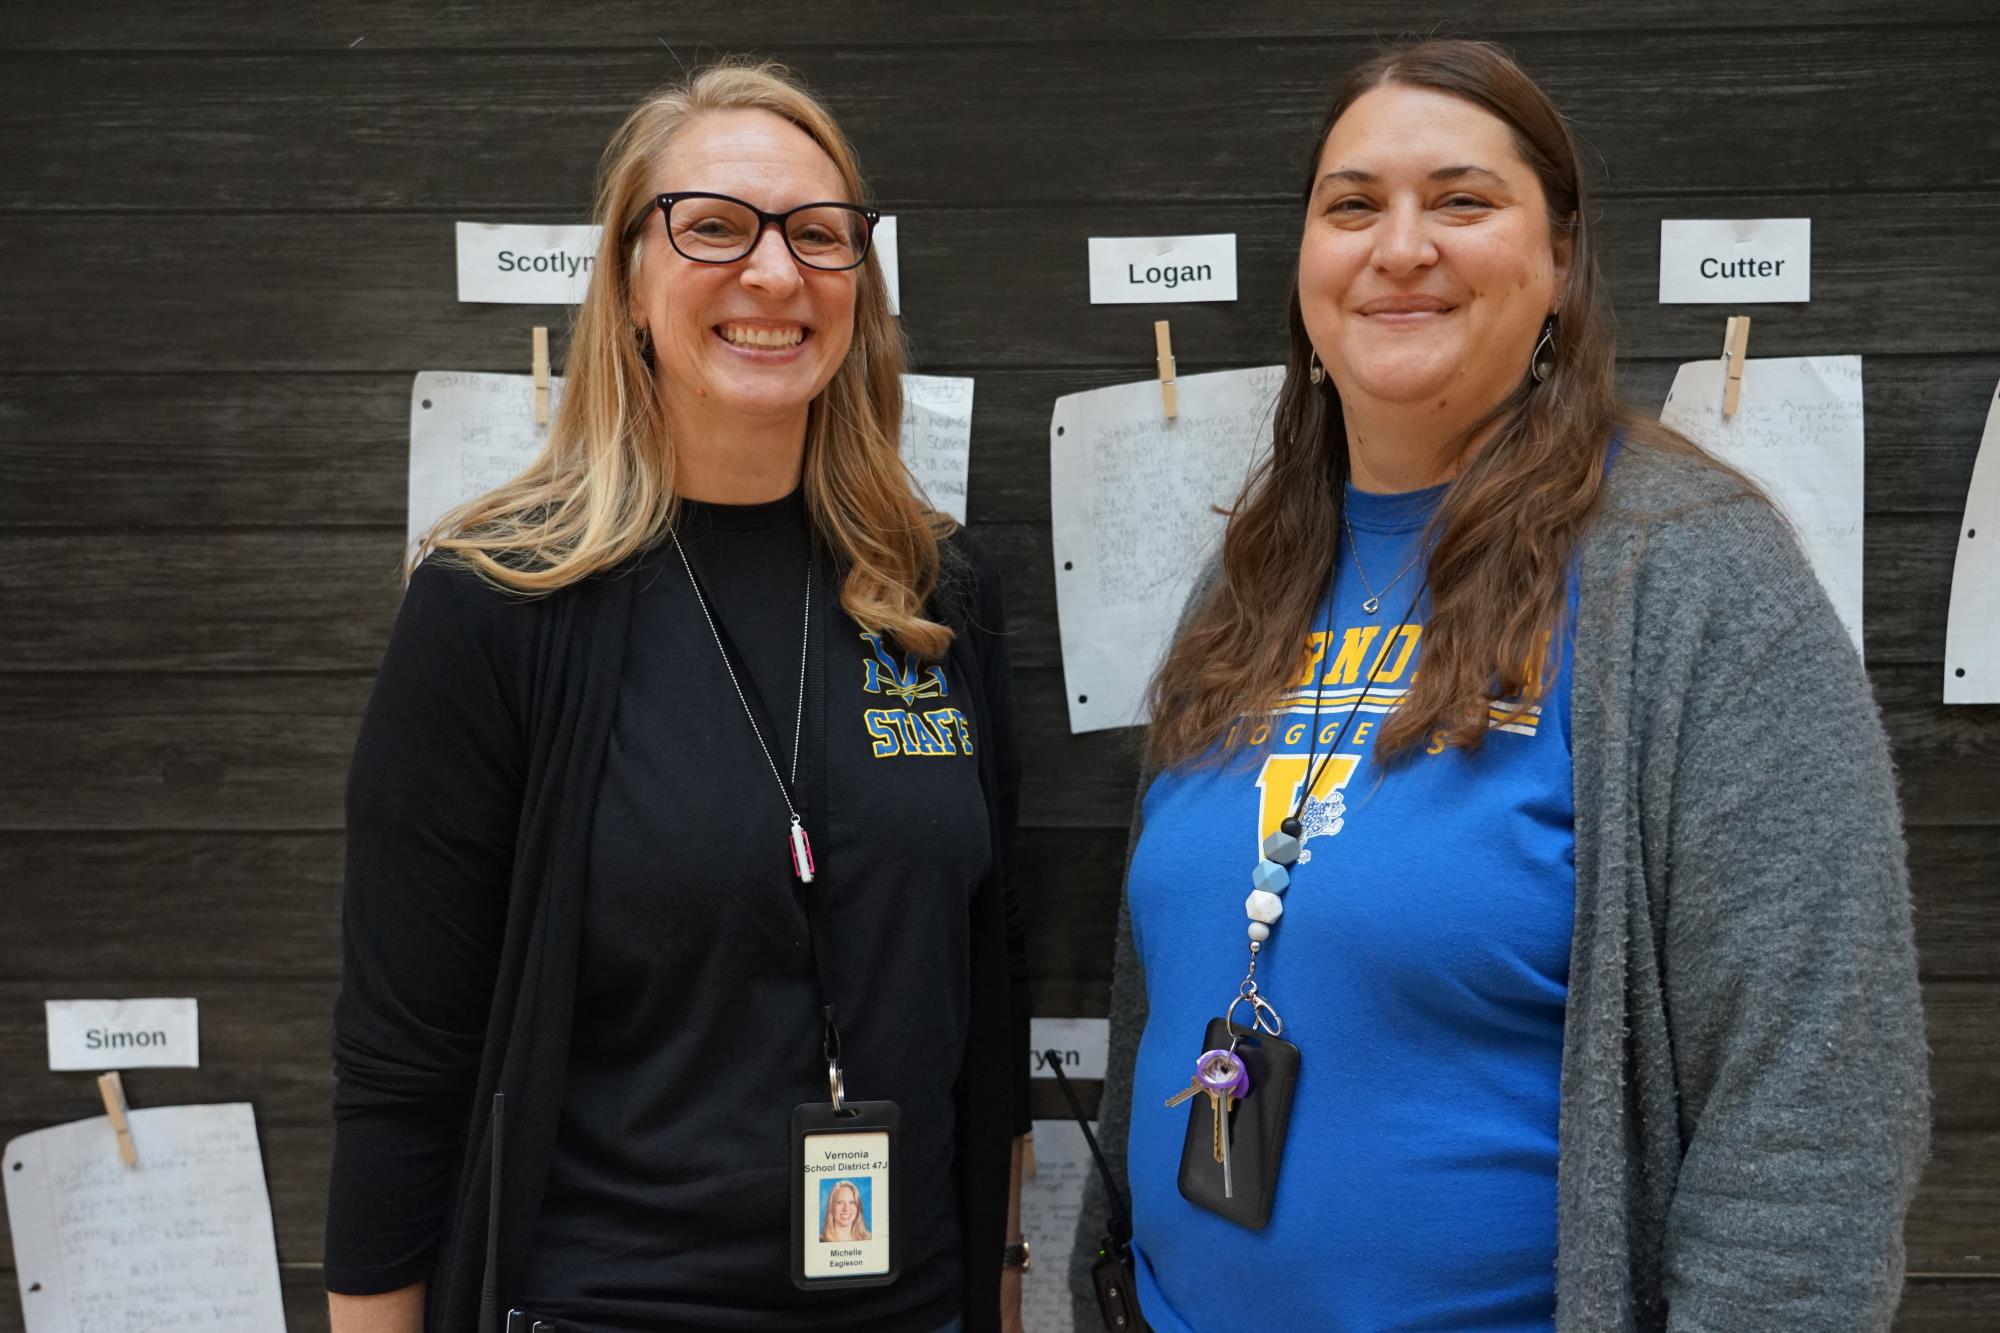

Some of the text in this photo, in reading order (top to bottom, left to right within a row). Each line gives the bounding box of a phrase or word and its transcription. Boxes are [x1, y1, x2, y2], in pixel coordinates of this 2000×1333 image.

[1128, 264, 1212, 288] Logan
[1700, 257, 1785, 279] Cutter
[864, 708, 974, 758] STAFF
[1224, 721, 1448, 755] OGGES
[86, 1028, 167, 1050] Simon
[824, 1150, 869, 1160] Vernonia
[804, 1161, 888, 1173] School District 47J
[830, 1248, 863, 1257] Michelle
